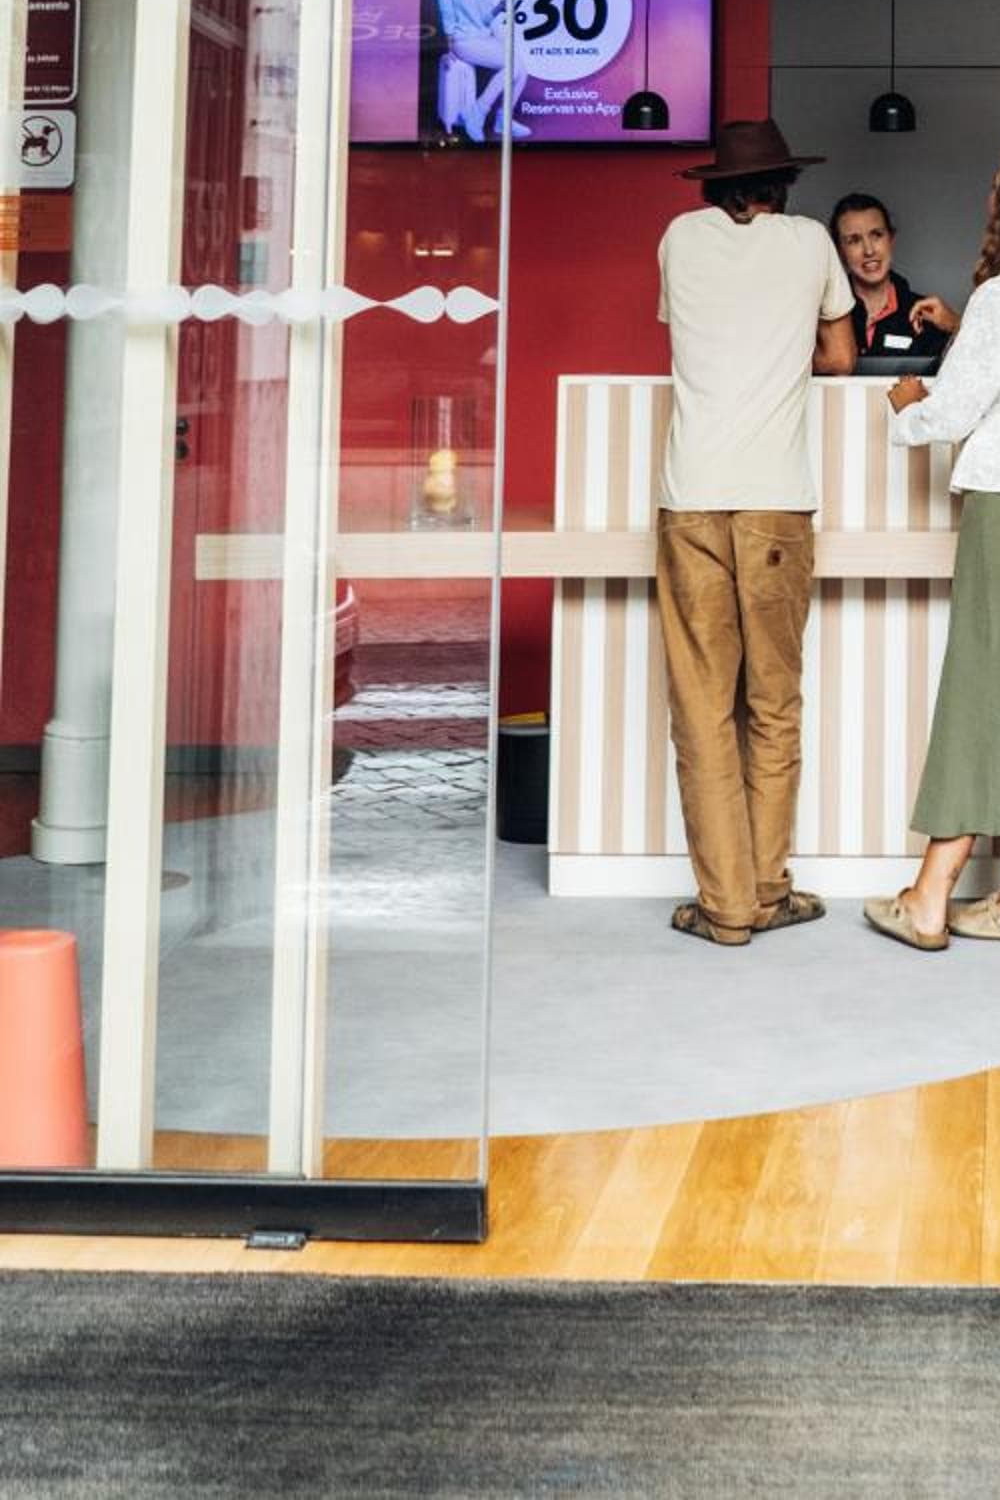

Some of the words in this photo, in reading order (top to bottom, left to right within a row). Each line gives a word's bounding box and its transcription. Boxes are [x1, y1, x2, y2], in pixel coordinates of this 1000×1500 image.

[544, 87, 599, 100] Exclusivo
[522, 102, 576, 114] Reservas
[577, 102, 594, 114] via
[595, 103, 621, 117] App
